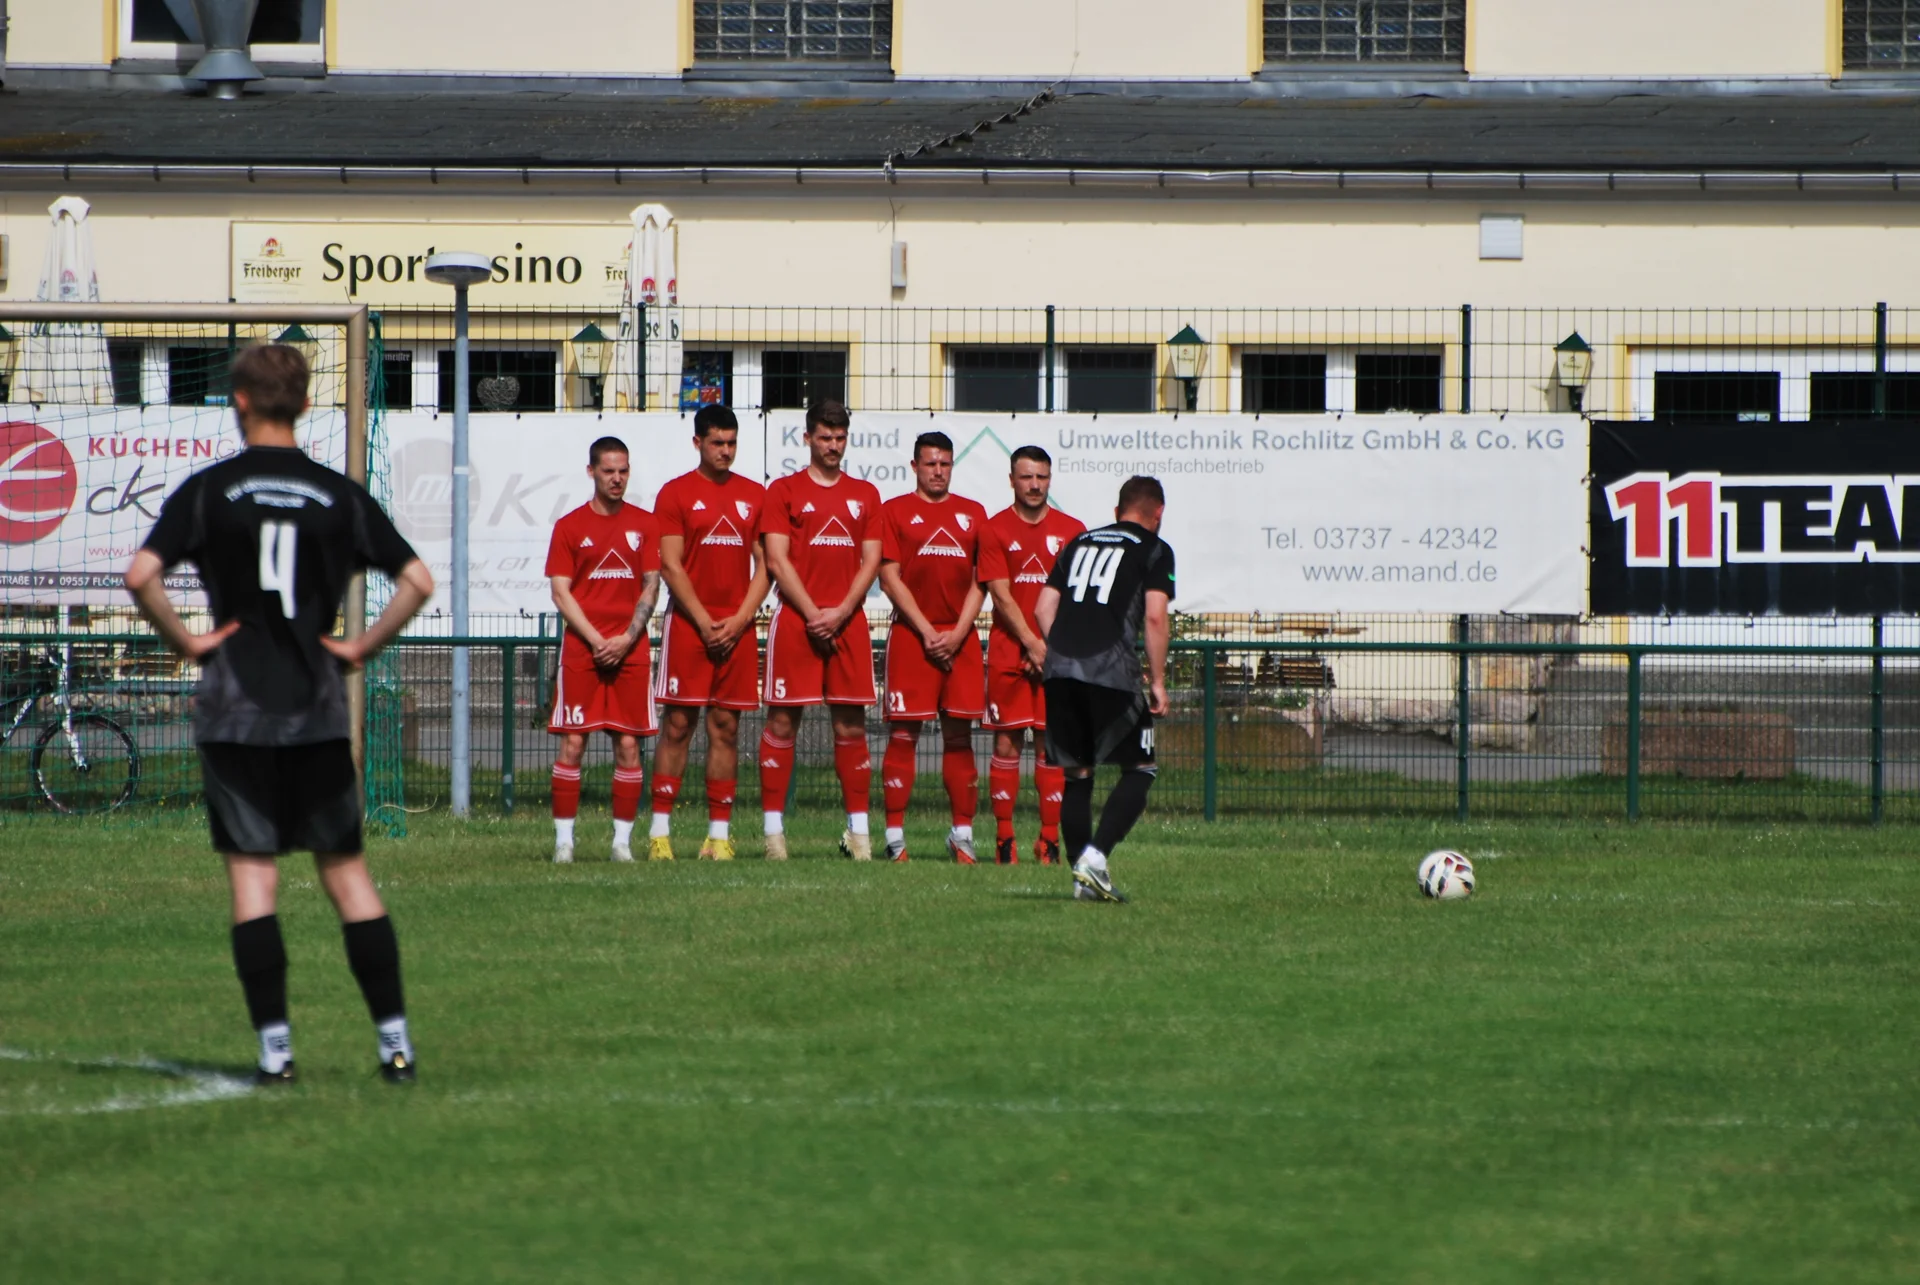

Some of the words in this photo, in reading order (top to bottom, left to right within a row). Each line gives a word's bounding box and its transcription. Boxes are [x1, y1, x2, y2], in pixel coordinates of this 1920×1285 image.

[243, 263, 302, 282] Freiberger
[322, 241, 582, 296] Sporsino
[850, 428, 899, 449] und
[1057, 429, 1243, 450] Umwelttechnik
[1252, 429, 1354, 450] Rochlitz
[1362, 429, 1440, 450] GmbH
[1449, 429, 1467, 450] &
[1476, 429, 1517, 450] Co.
[1526, 429, 1565, 449] KG
[858, 463, 906, 481] von
[1057, 457, 1265, 477] Entsorgungsfachbetrieb
[1604, 471, 1920, 567] 11TEA
[1261, 527, 1304, 550] Tel.
[1313, 527, 1392, 549] 03737
[1418, 527, 1498, 549] 42342
[917, 547, 967, 558] AMAND
[258, 518, 299, 620] 4
[1066, 545, 1126, 605] 44
[1302, 559, 1498, 582] www.amand.de
[33, 576, 45, 586] 17
[60, 577, 90, 587] 09557
[774, 678, 787, 699] 5
[563, 704, 585, 726] 16
